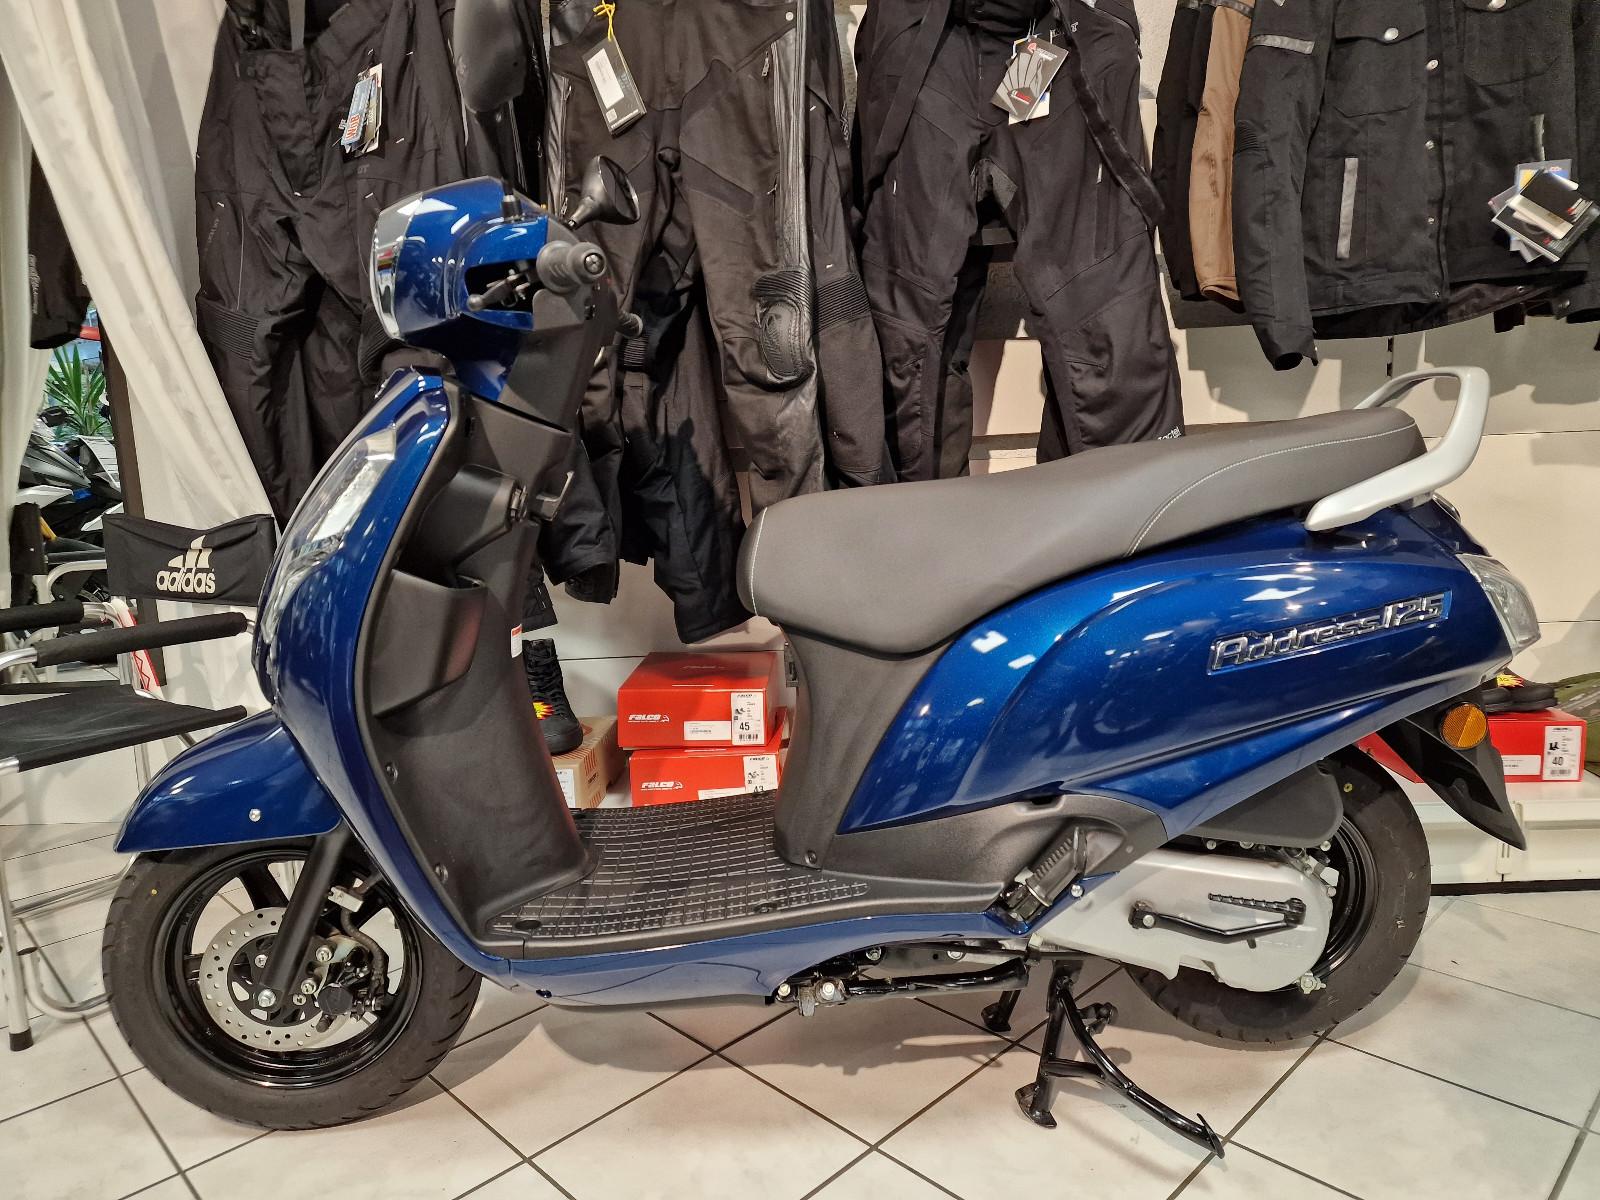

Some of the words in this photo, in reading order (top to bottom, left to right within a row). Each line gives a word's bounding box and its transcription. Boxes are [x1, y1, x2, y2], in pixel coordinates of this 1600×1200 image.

[156, 567, 216, 594] adidas
[1211, 612, 1384, 671] Address
[1382, 593, 1445, 629] 125
[739, 721, 750, 731] 45
[1552, 756, 1564, 766] 40
